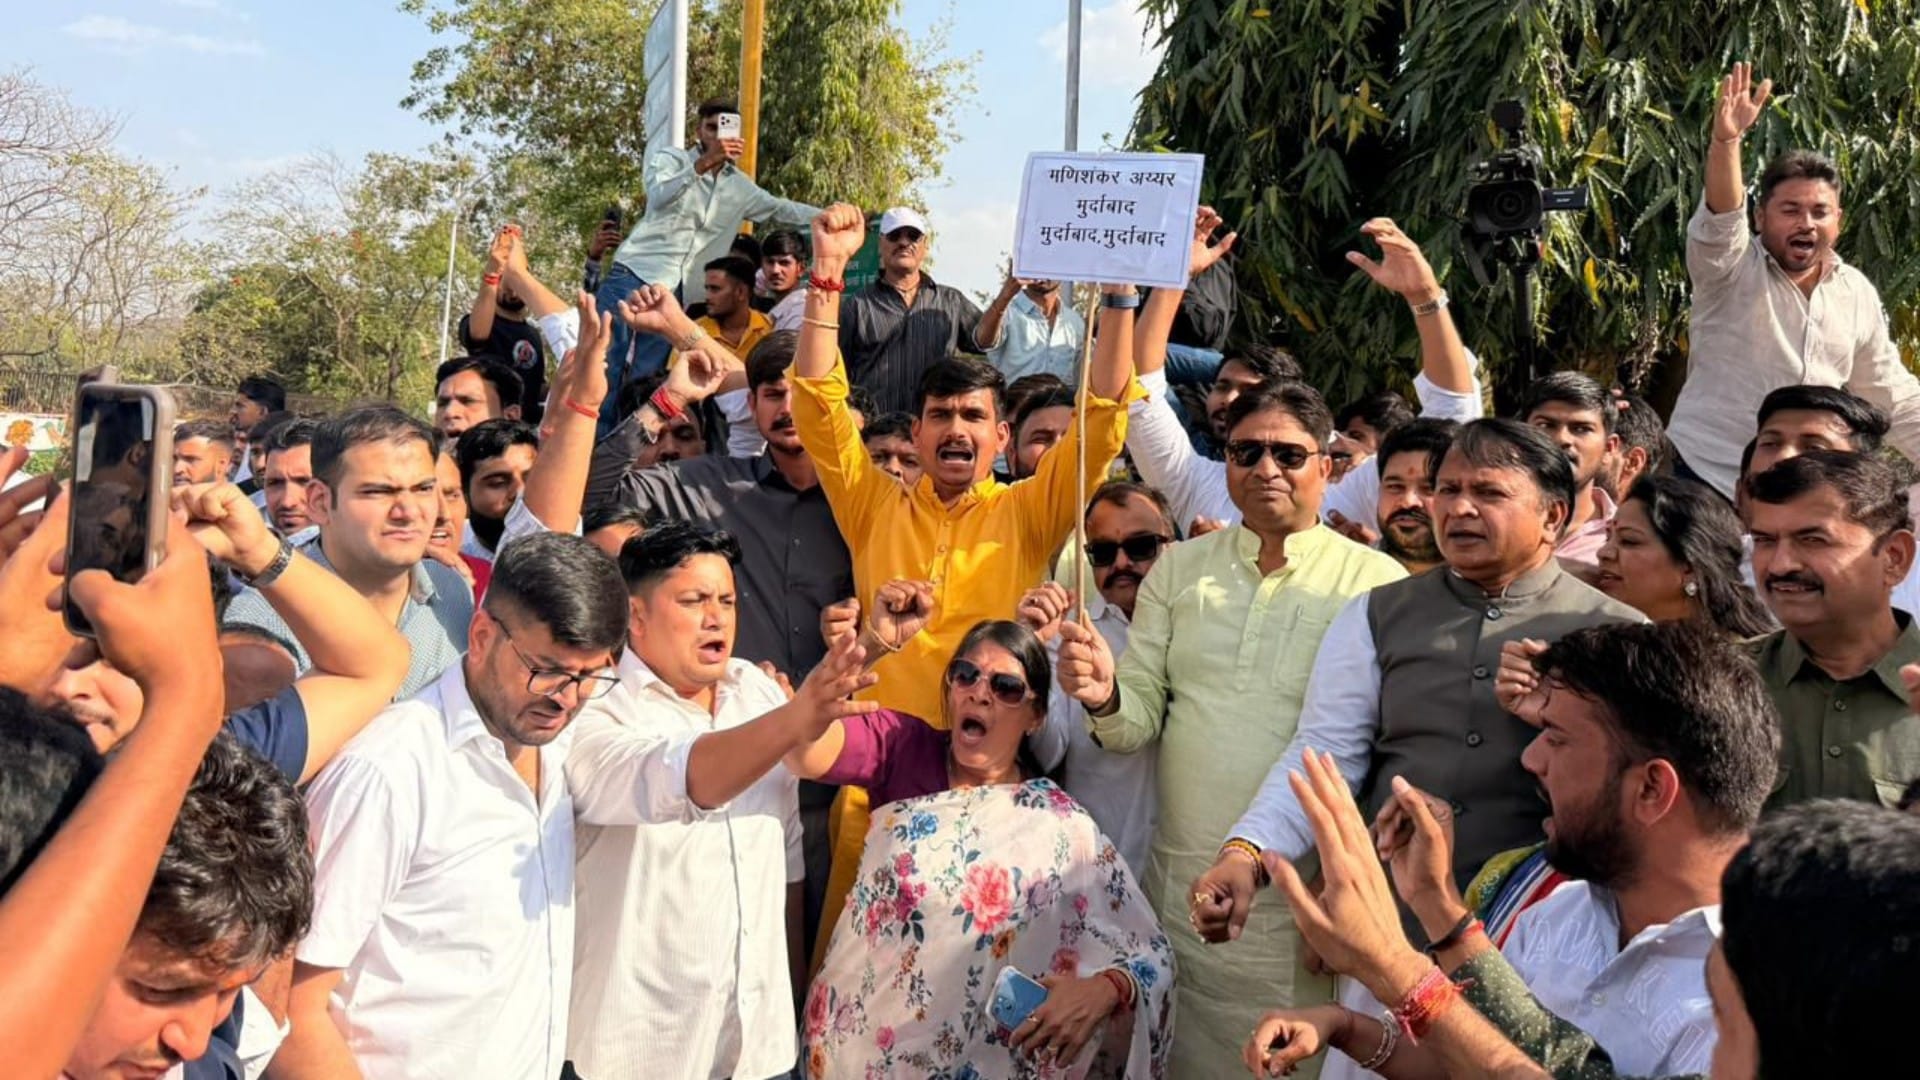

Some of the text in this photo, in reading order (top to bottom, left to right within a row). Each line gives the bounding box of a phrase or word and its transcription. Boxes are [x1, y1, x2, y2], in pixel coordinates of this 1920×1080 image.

[1049, 164, 1176, 187] मणिशंकर अय्यर
[1076, 194, 1137, 218] मुर्दाबाद
